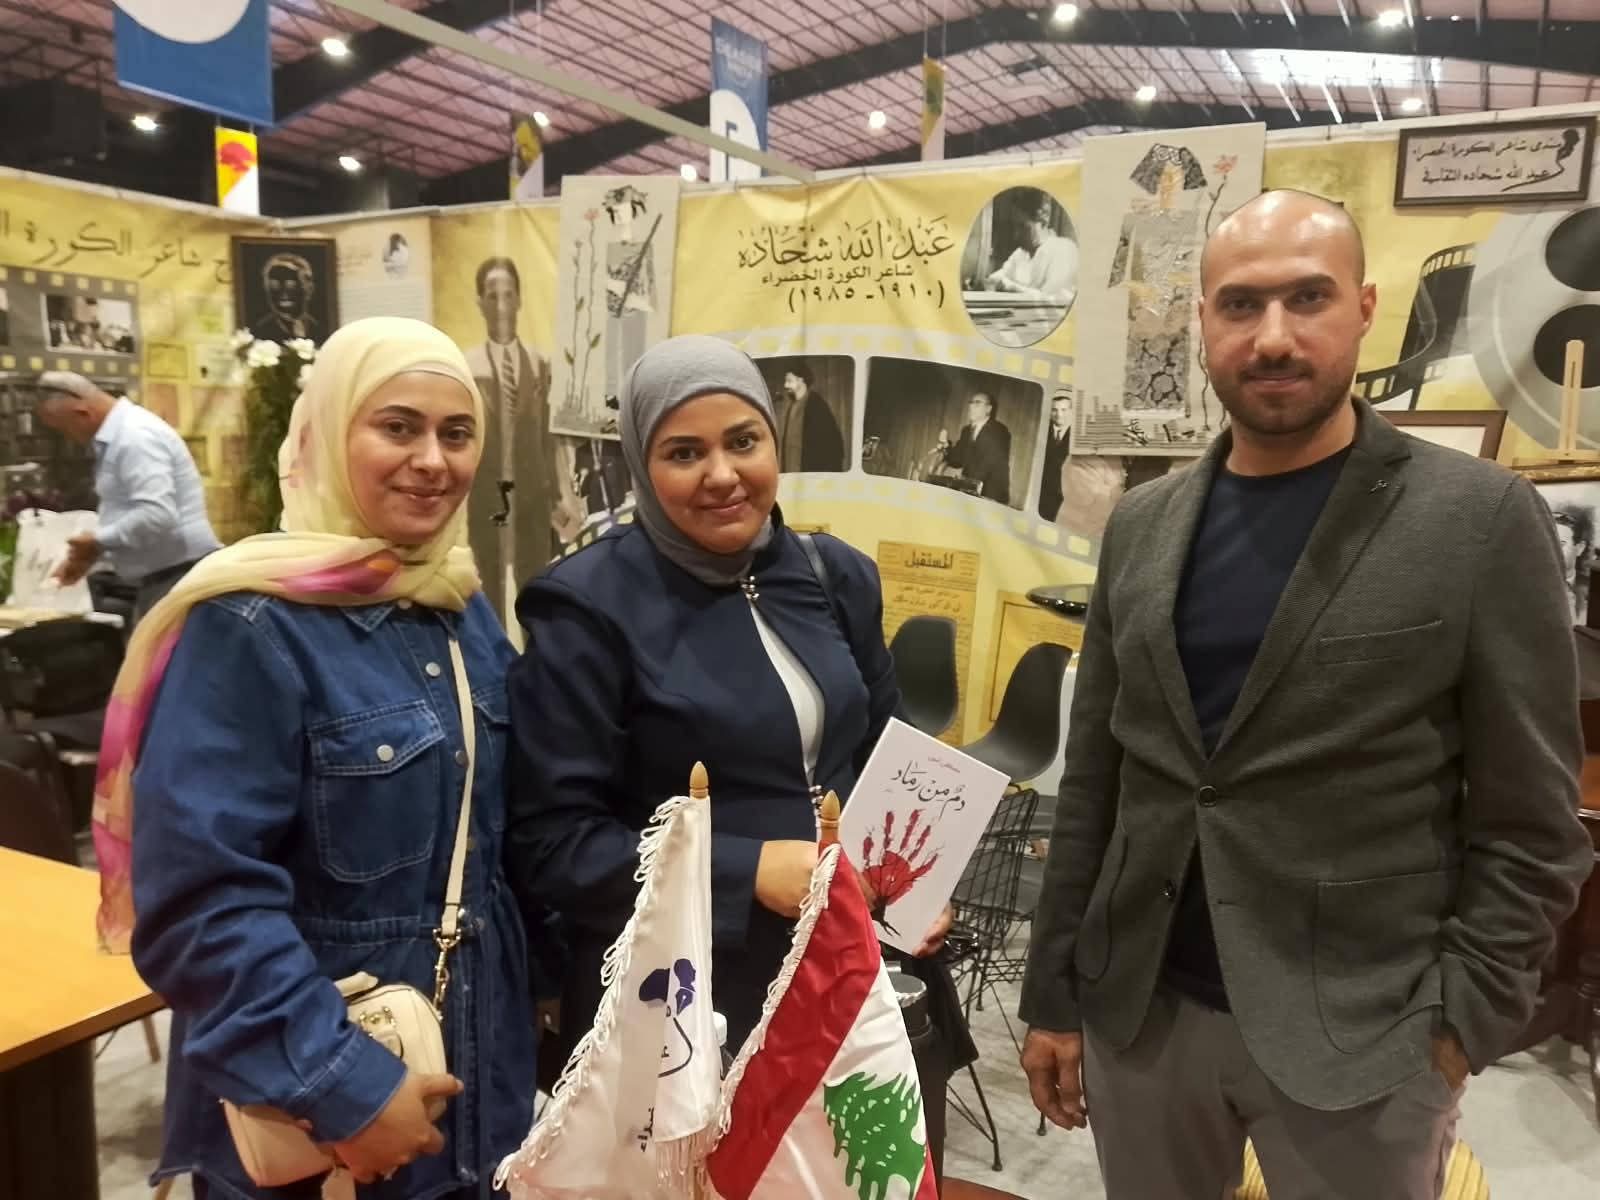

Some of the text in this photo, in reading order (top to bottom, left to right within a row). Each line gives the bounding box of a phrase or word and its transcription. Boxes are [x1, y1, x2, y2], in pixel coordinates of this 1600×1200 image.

[1506, 160, 1523, 179] الله
[1525, 168, 1551, 180] عبد
[24, 220, 132, 267] الكورة
[139, 236, 202, 278] شاعر
[762, 263, 914, 287] شاعر الكورة الخضراء
[904, 549, 954, 570] المستقبل
